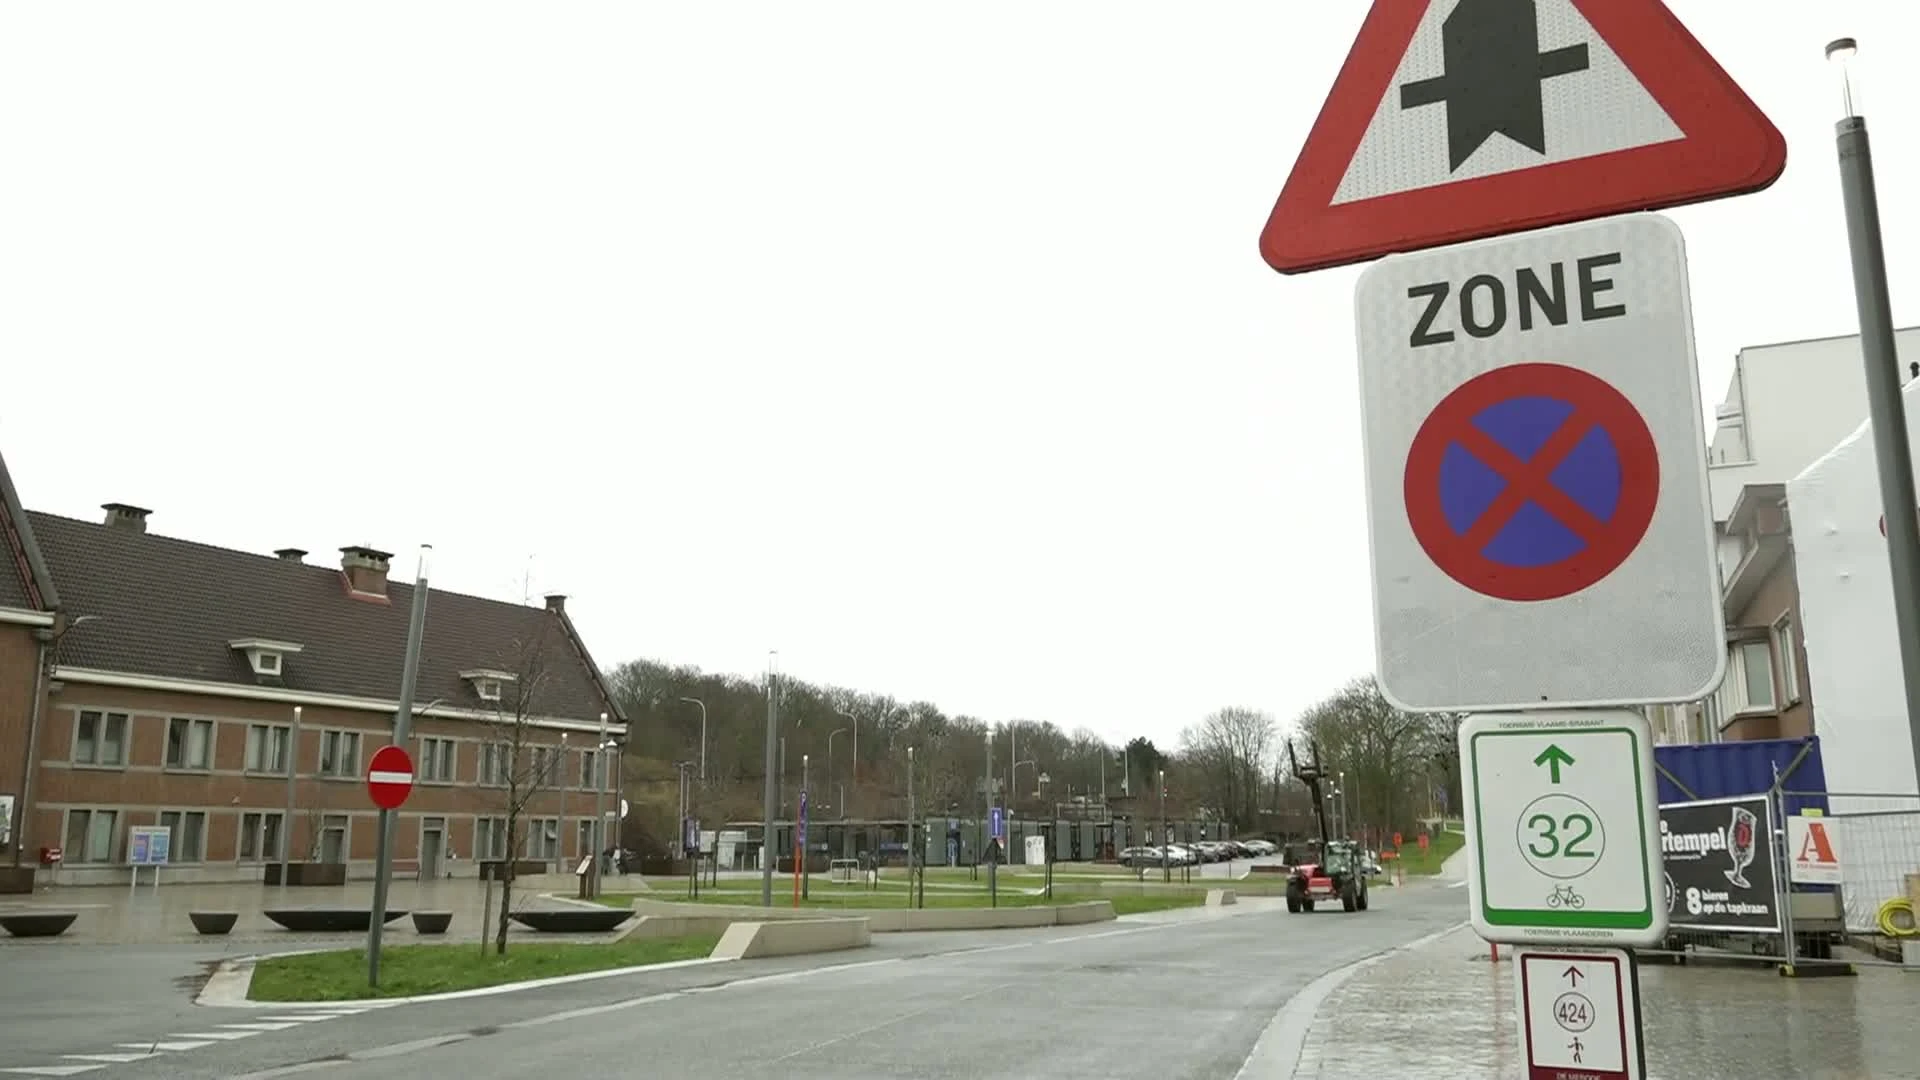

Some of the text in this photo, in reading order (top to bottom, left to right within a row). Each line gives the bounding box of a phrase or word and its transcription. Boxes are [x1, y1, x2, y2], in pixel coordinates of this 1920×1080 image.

[1408, 251, 1626, 348] ZONE
[1527, 813, 1596, 859] 32
[1662, 826, 1728, 856] rtempel
[1796, 822, 1838, 863] A
[1686, 886, 1703, 915] 8
[1702, 887, 1729, 901] bieren
[1703, 900, 1769, 916] op de tapkraan
[1558, 1002, 1588, 1024] 424
